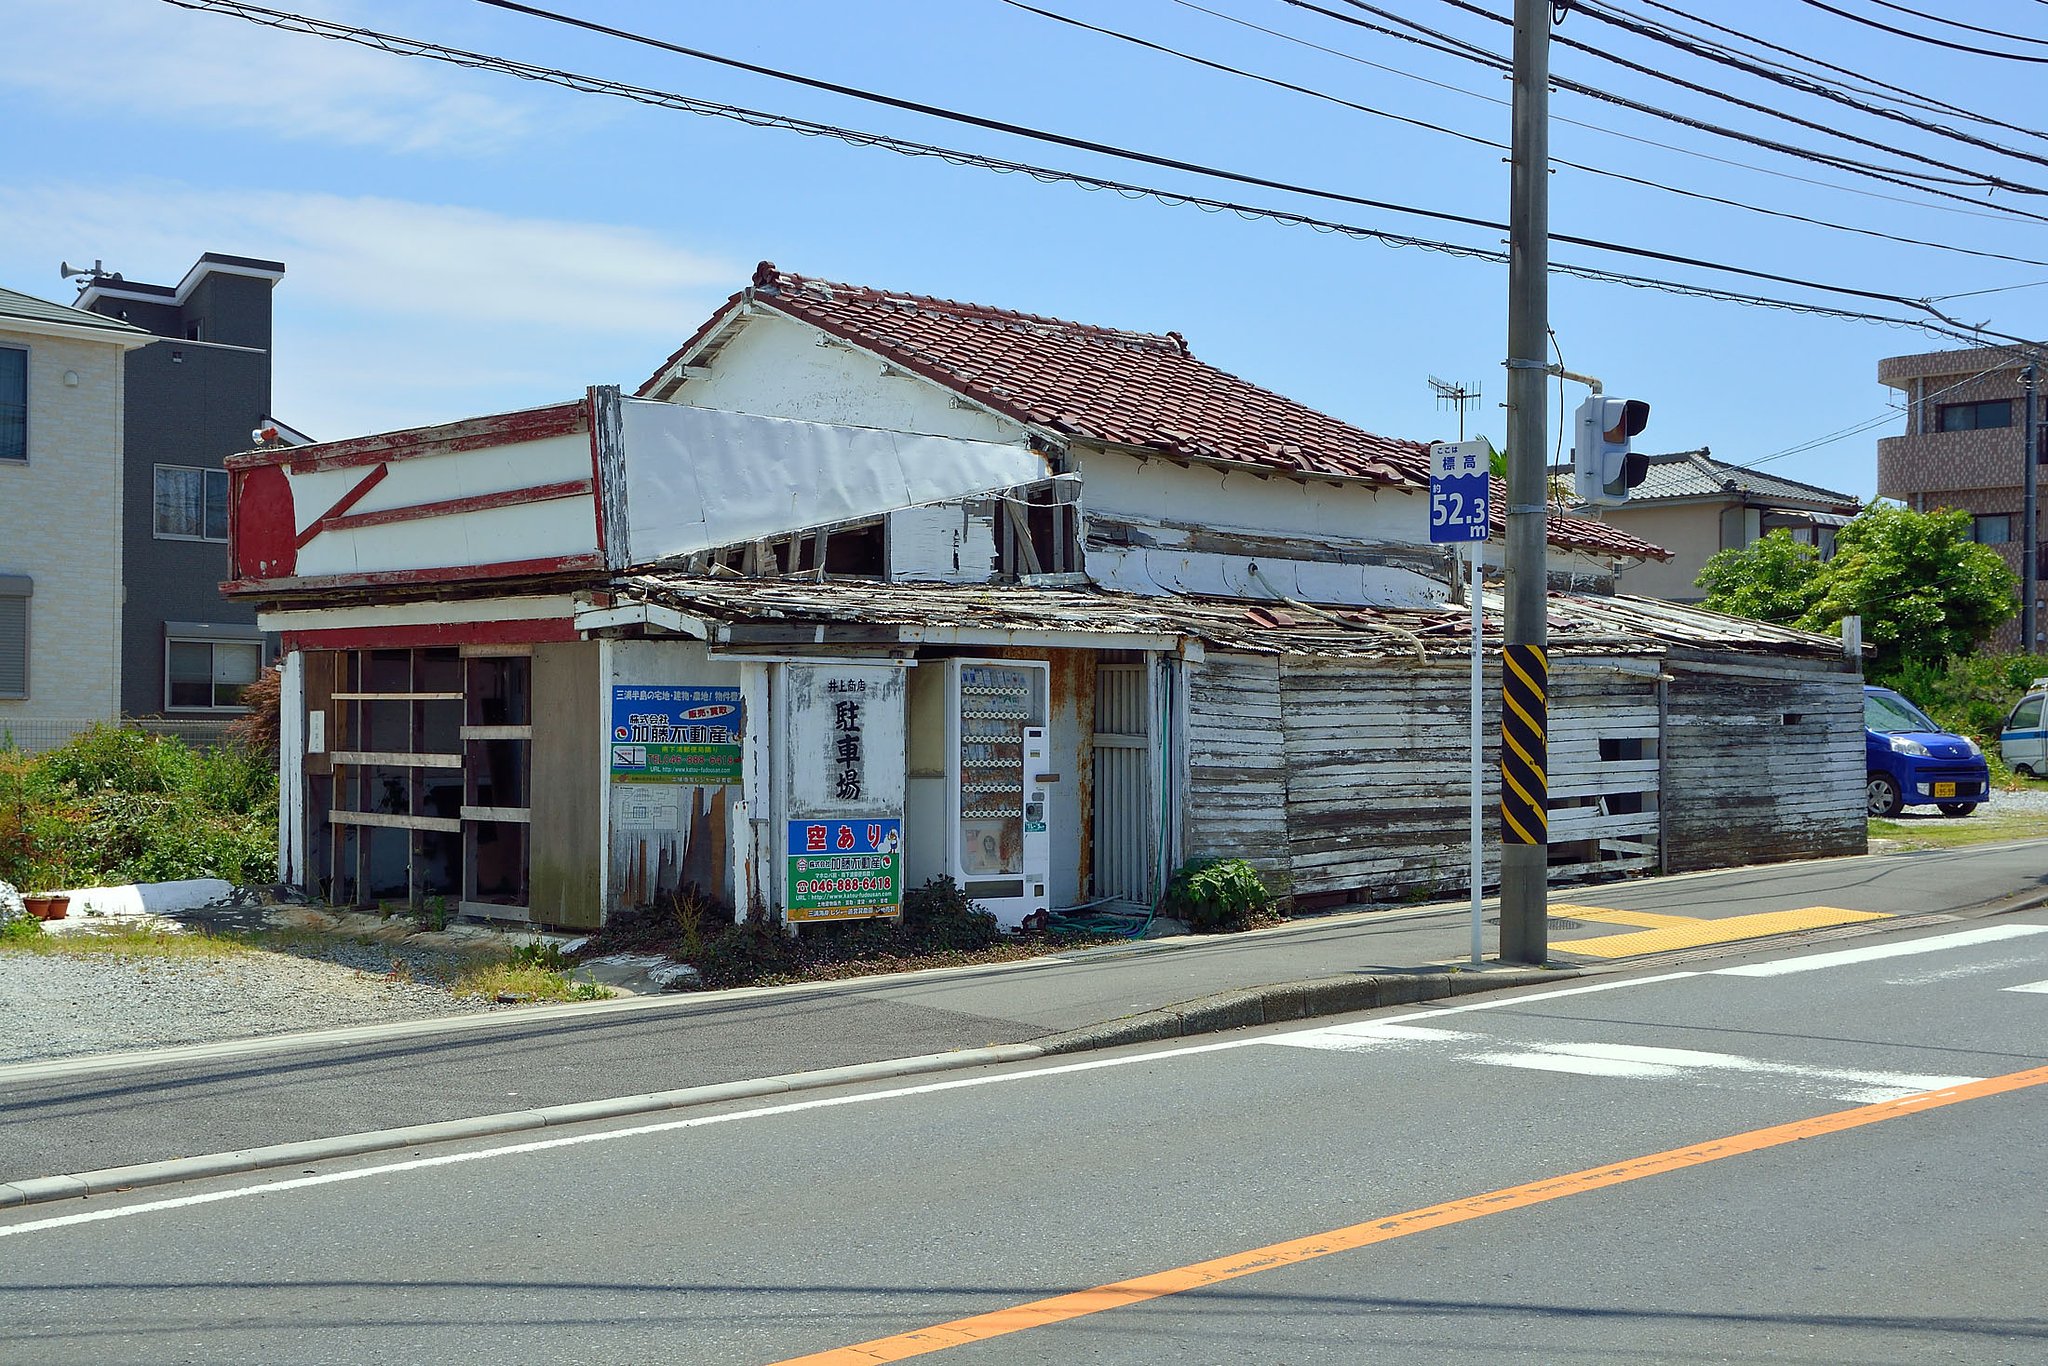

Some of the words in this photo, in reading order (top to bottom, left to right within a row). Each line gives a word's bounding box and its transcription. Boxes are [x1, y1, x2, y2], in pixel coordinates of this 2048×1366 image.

[1437, 446, 1458, 454] ここは
[1442, 455, 1476, 471] 標高
[1432, 484, 1441, 494] 約
[1433, 492, 1485, 526] 52.3
[1470, 525, 1486, 537] m
[828, 679, 866, 693] 井上商店
[629, 713, 669, 724] 株式会社
[631, 725, 729, 743] 加藤不動産
[835, 701, 861, 800] 駐車場
[807, 824, 882, 851] 空あり
[809, 860, 831, 869] 株式会社
[831, 857, 881, 871] 加藤不動産
[810, 876, 891, 893] 046-888-6418
